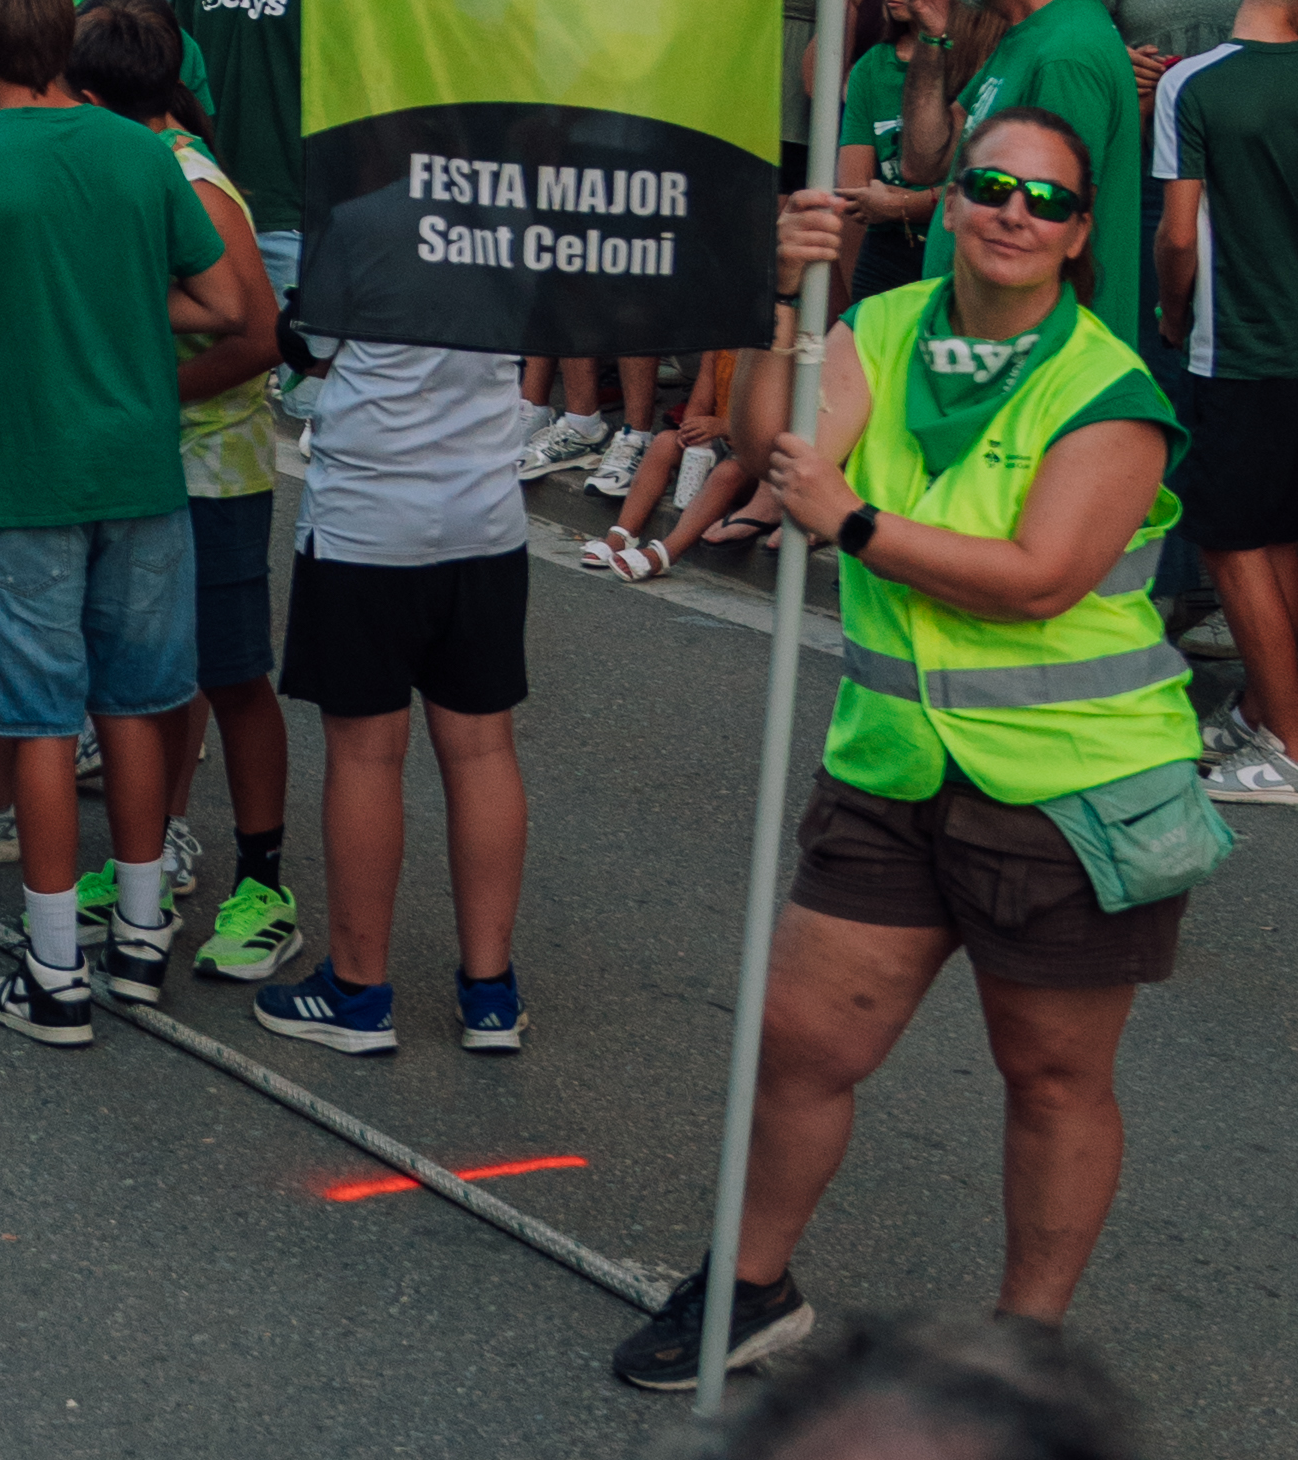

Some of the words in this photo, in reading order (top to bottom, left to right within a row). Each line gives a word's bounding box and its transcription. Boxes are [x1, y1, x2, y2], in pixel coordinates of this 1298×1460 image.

[408, 152, 527, 209] FESTA
[536, 165, 687, 217] MAJOR
[417, 215, 514, 268] Sant
[523, 224, 675, 276] Celoni
